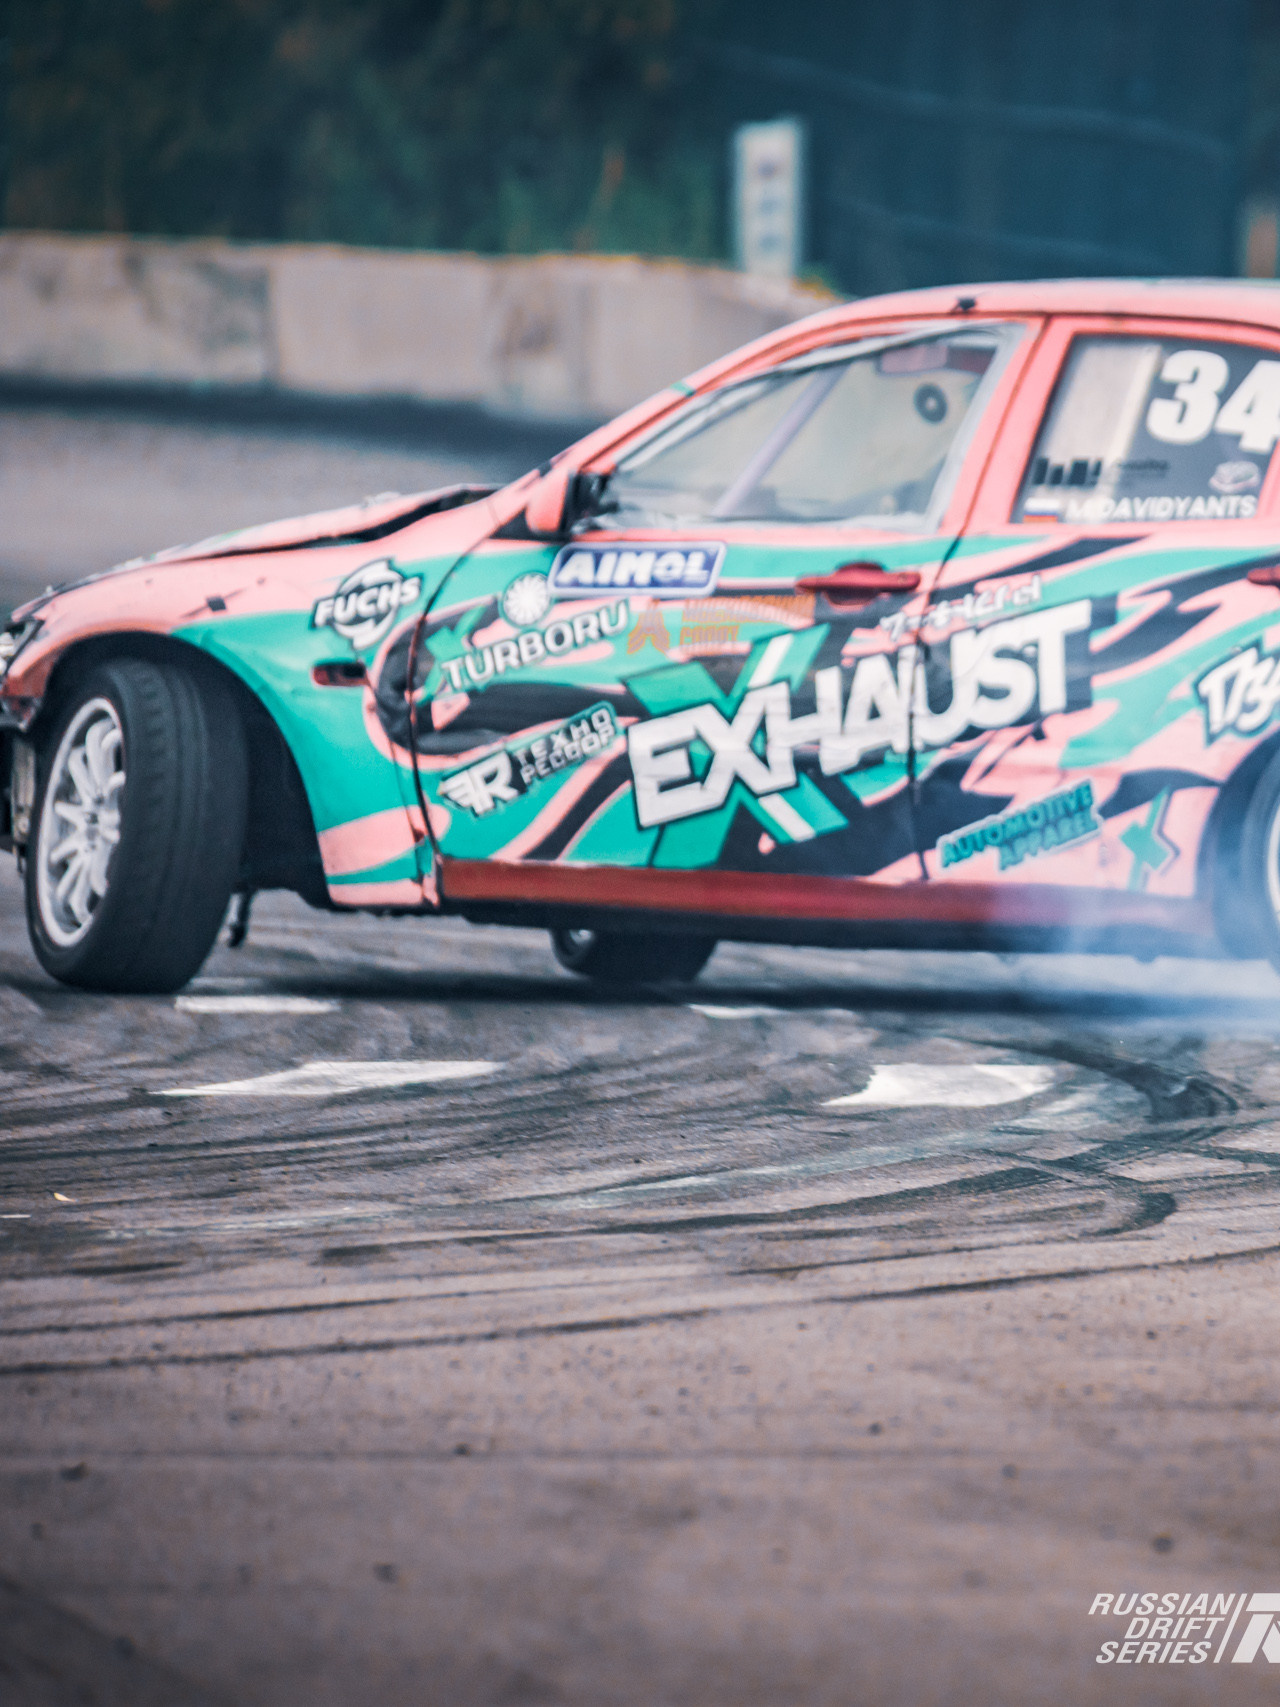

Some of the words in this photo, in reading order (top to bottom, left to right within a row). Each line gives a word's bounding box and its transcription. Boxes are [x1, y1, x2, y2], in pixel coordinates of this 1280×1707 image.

[314, 576, 420, 627] FUCHS
[556, 551, 710, 586] AIMOL
[441, 601, 628, 689] TURBORU
[628, 600, 1092, 828] EXHAUST
[942, 783, 1094, 868] AUTOMOTIVE
